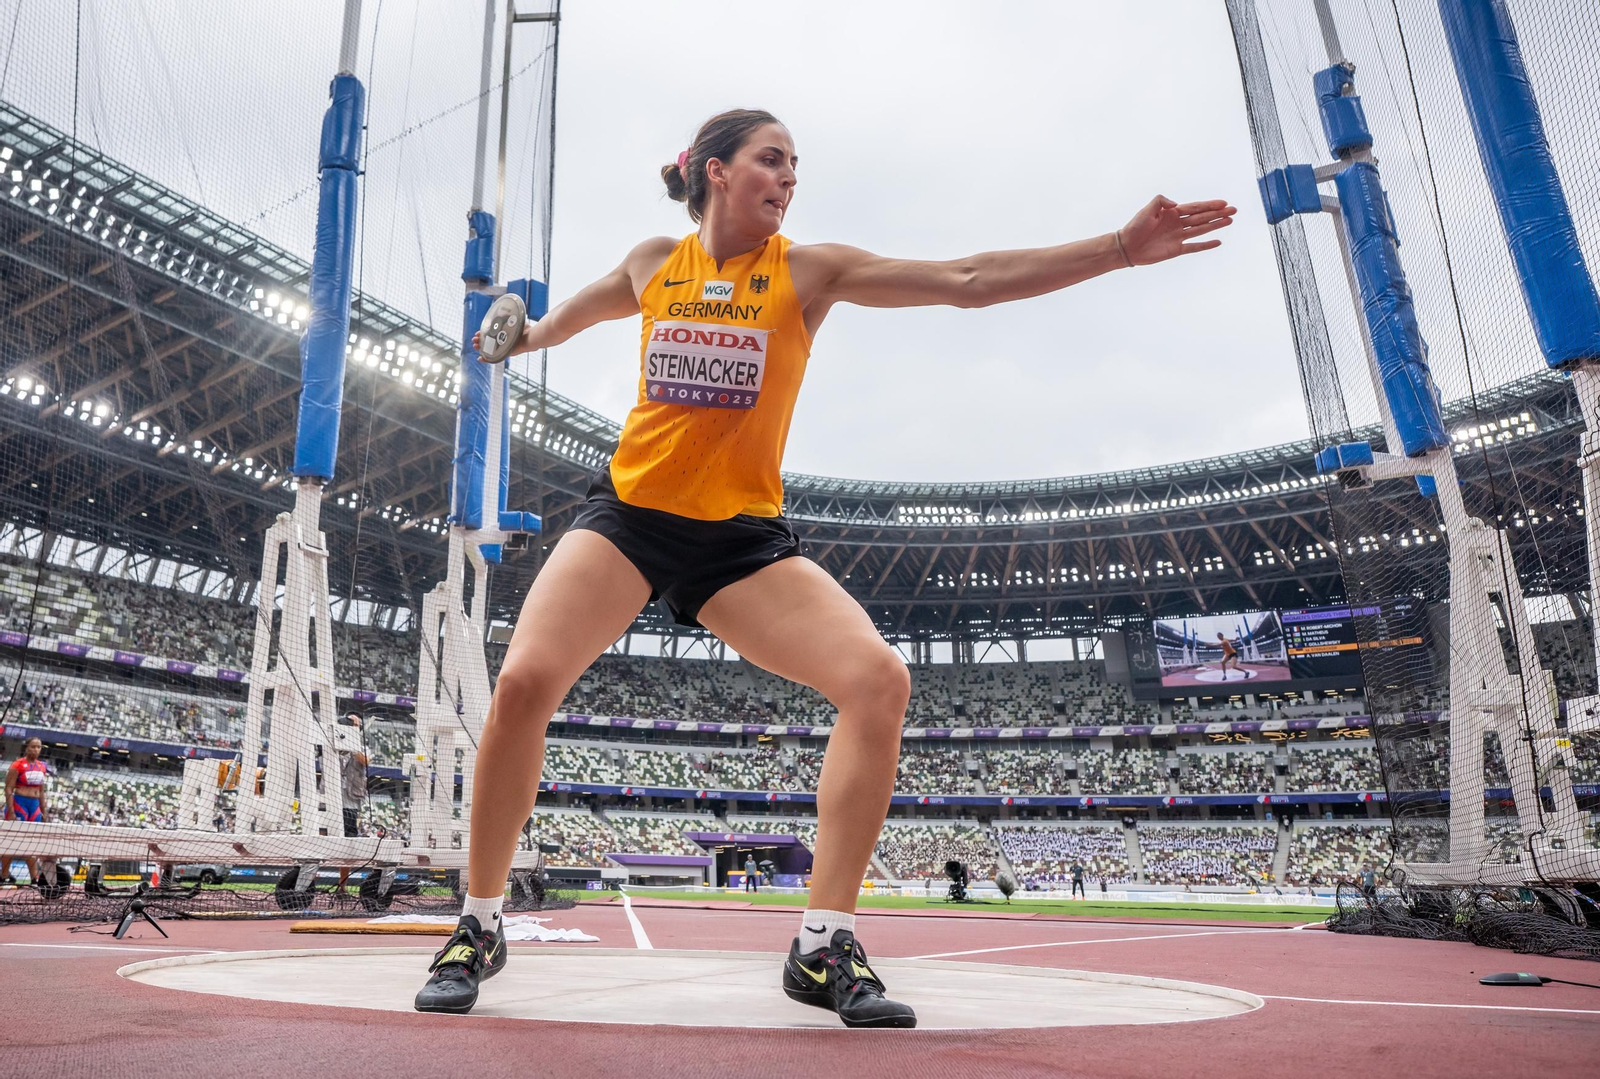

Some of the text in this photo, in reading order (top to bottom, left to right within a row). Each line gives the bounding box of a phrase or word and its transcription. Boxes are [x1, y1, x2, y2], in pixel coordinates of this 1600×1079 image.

[704, 285, 733, 297] WGV
[668, 302, 763, 320] GERMANY
[651, 328, 763, 352] HONDA
[648, 352, 759, 387] STEINACKER
